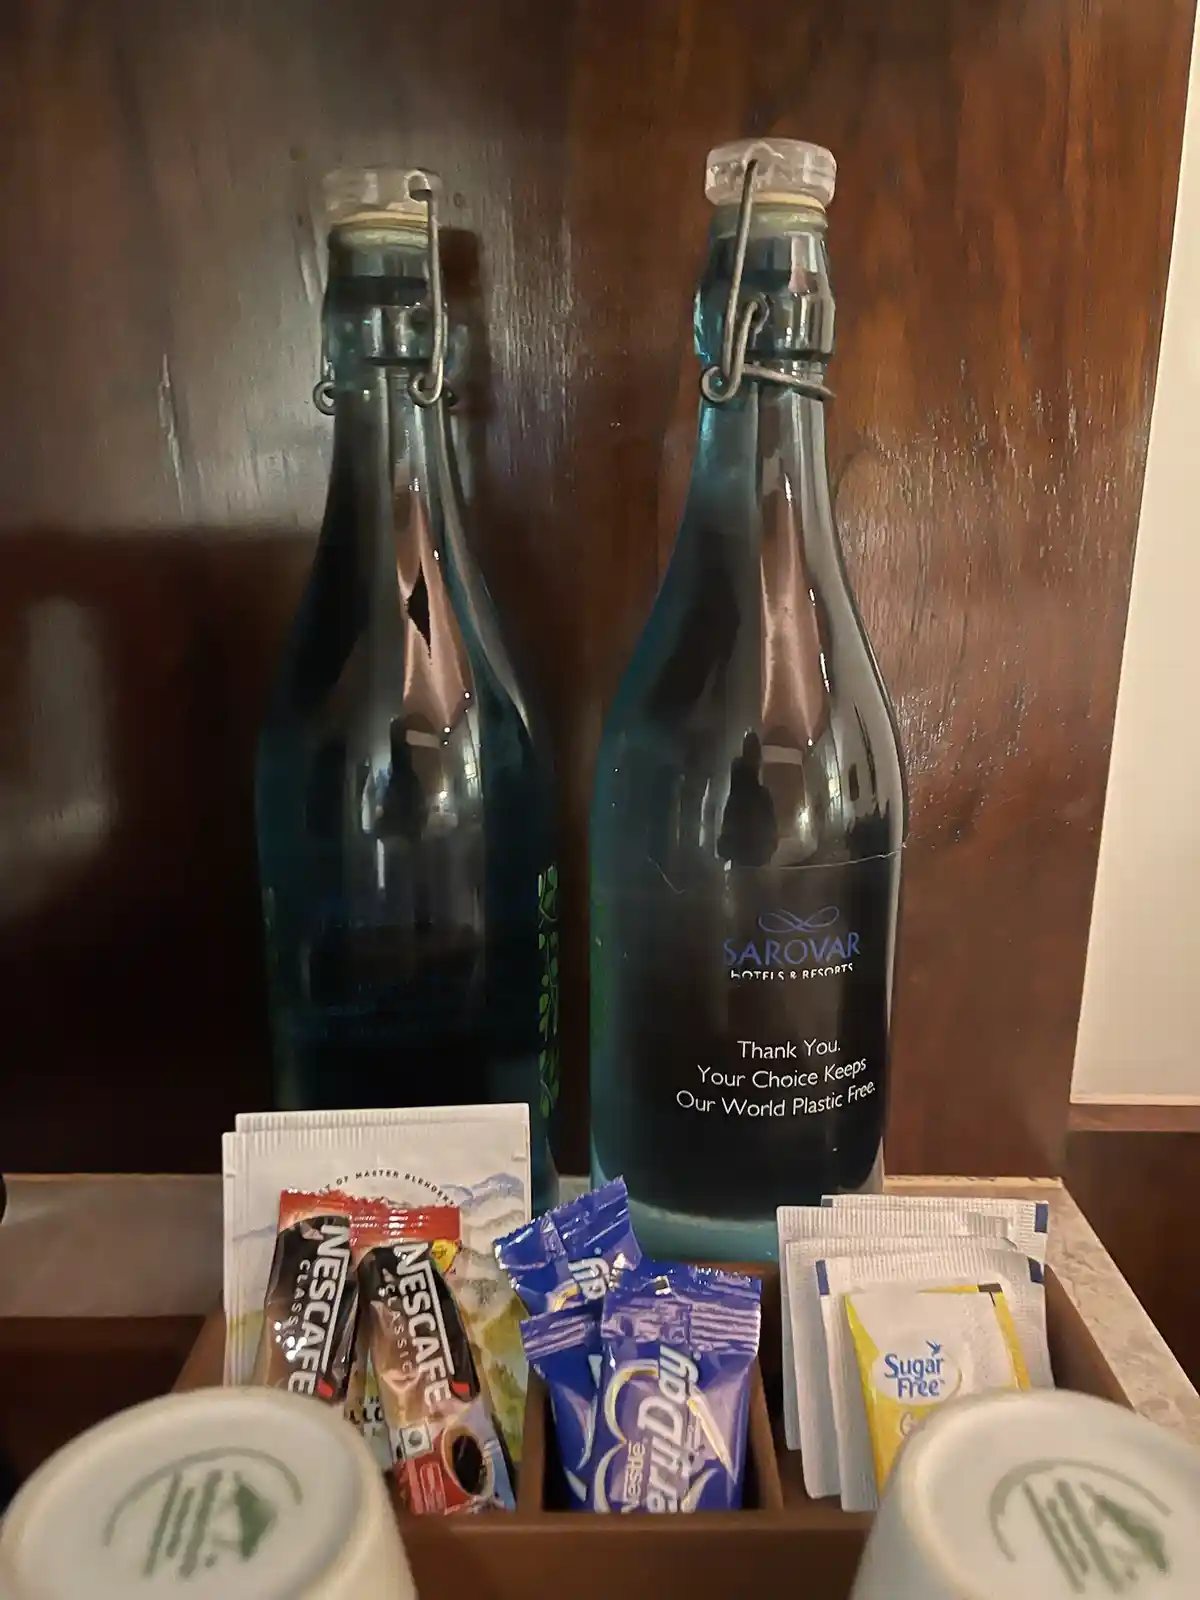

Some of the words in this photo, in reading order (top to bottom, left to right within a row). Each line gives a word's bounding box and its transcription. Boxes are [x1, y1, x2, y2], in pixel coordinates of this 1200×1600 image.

[723, 932, 861, 966] SAROVAR
[802, 962, 853, 980] RESORTS
[737, 1040, 797, 1059] Thank
[803, 1038, 841, 1057] You.
[697, 1064, 745, 1087] Your
[752, 1070, 818, 1089] Choice
[824, 1057, 867, 1083] Keeps
[676, 1089, 716, 1113] Our
[721, 1096, 786, 1117] World
[792, 1092, 843, 1116] Plastic
[847, 1080, 876, 1104] Free.
[386, 1284, 413, 1375] CLASSIC
[884, 1353, 944, 1380] Sugar
[897, 1378, 940, 1399] Free
